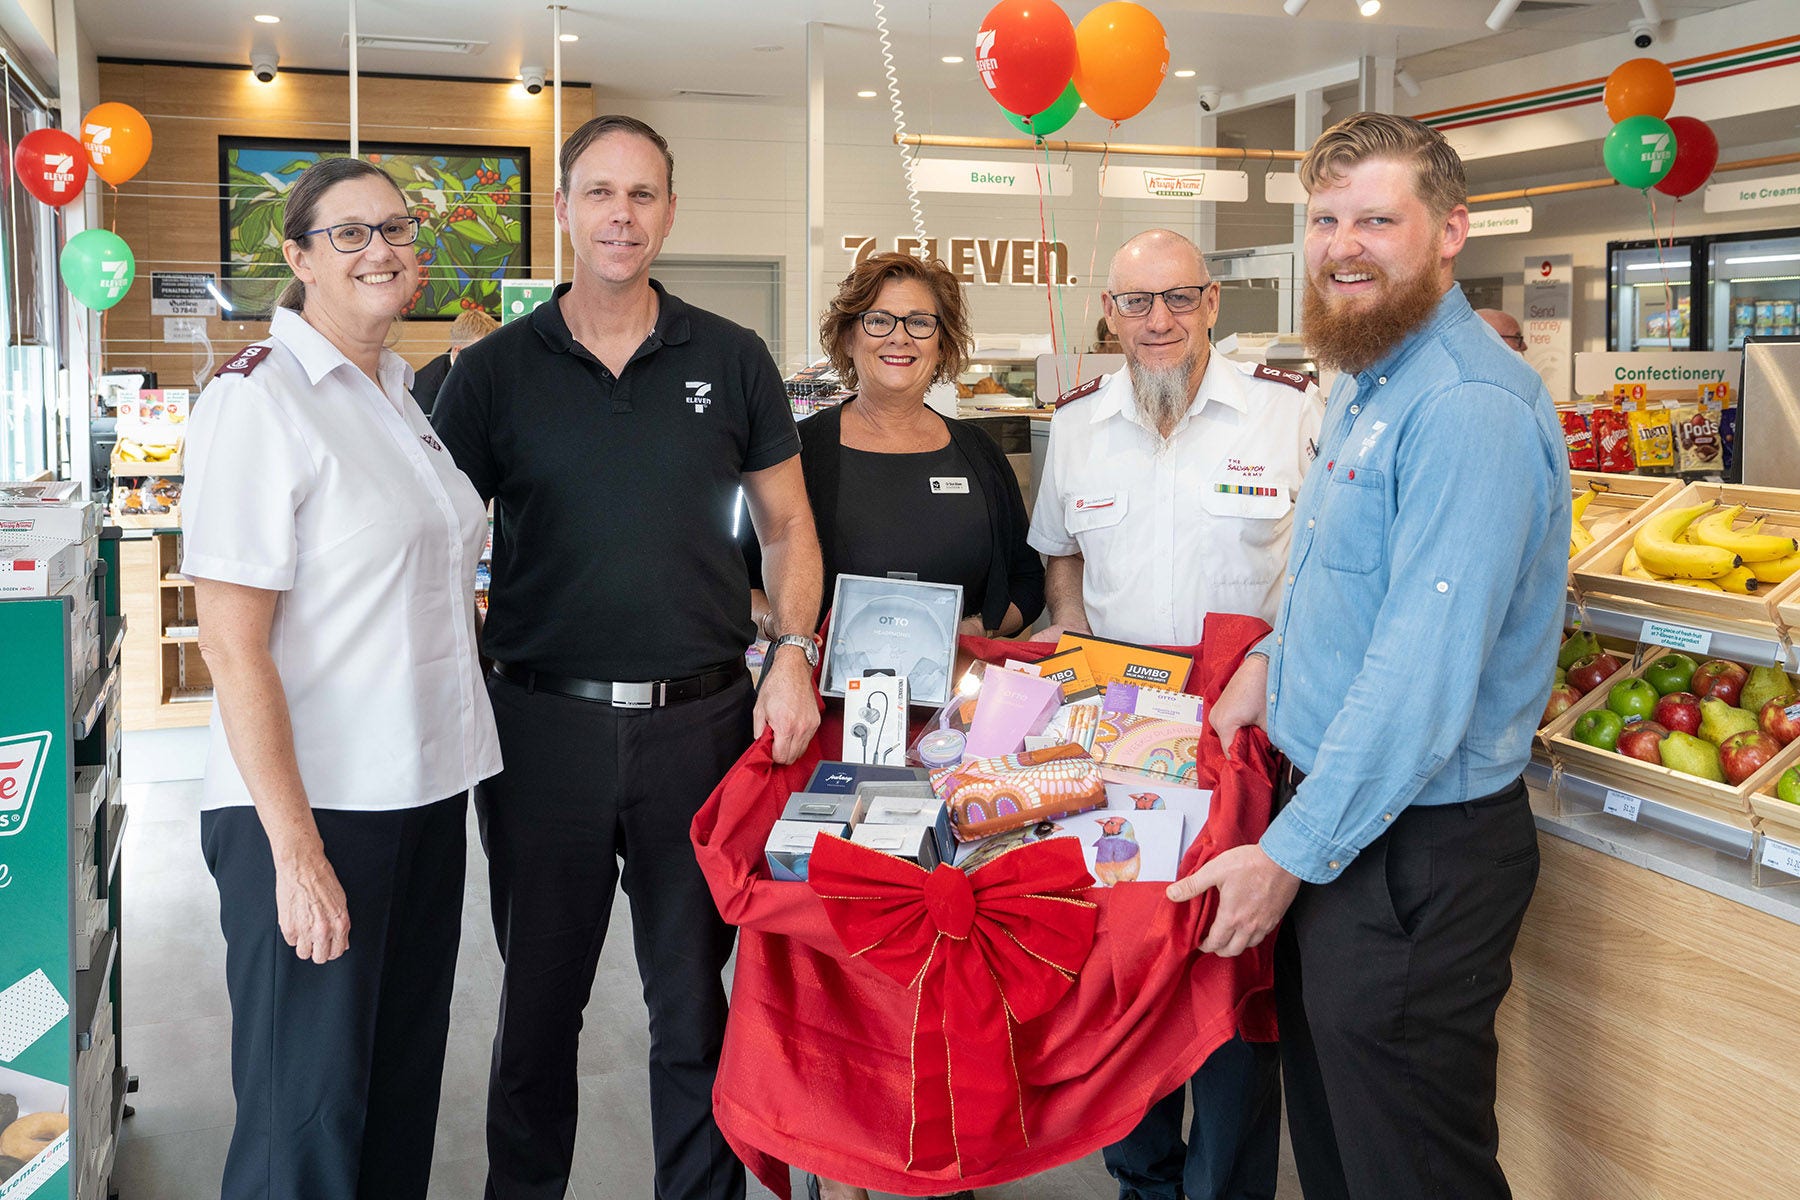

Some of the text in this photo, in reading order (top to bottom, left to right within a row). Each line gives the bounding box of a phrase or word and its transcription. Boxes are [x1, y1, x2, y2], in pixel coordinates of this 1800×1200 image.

[85, 123, 112, 165] 7
[1641, 133, 1670, 173] 7
[45, 154, 74, 192] 7
[971, 172, 1015, 191] Bakery
[1739, 191, 1757, 200] Ice
[1487, 218, 1519, 228] Services
[101, 261, 128, 298] 7
[1530, 305, 1556, 318] Send
[1530, 321, 1561, 334] money
[1530, 334, 1551, 345] here
[1614, 366, 1726, 384] Confectionery
[686, 381, 712, 413] 7
[1684, 419, 1720, 440] Pods
[880, 616, 909, 626] OTTO
[1682, 637, 1699, 645] product
[1127, 665, 1169, 679] JUMBO
